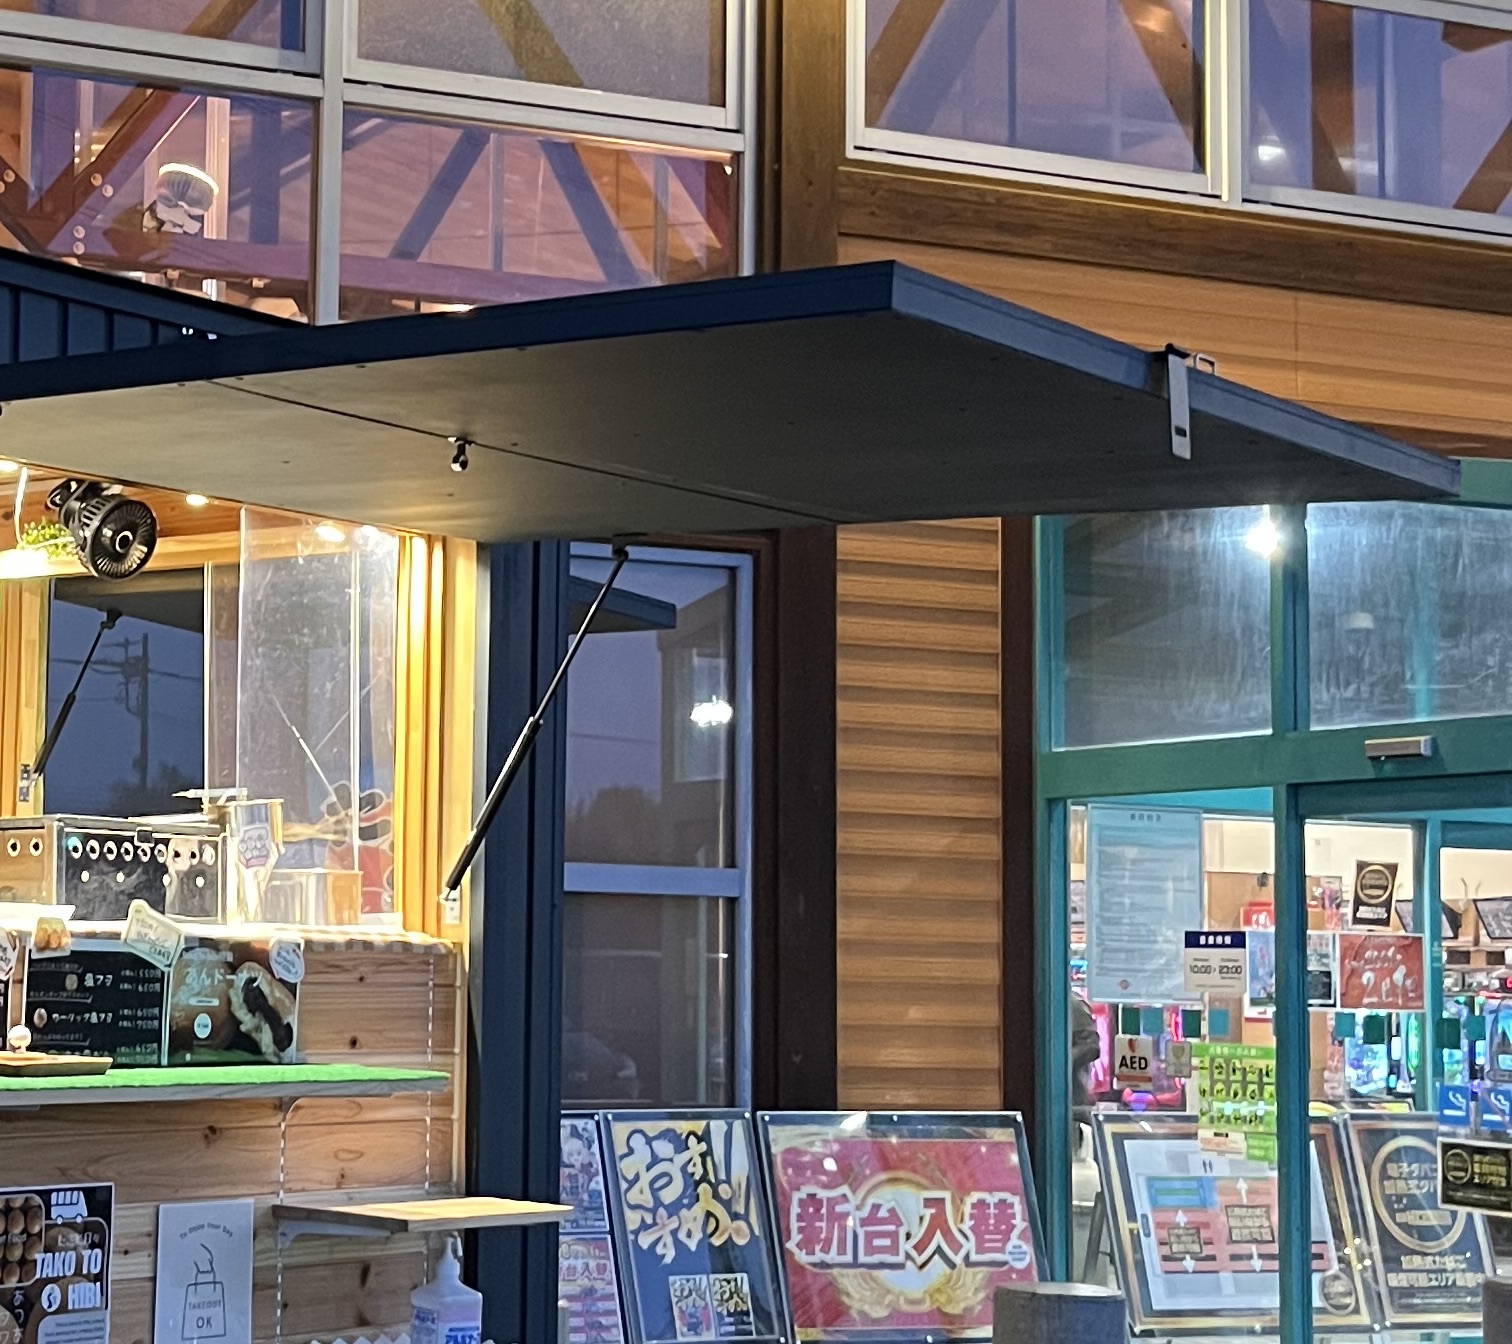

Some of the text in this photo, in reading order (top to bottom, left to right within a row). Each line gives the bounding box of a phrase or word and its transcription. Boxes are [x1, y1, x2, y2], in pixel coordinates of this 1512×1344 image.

[1190, 965, 1242, 975] 10:00 23:00
[1119, 1055, 1149, 1070] AED
[790, 1187, 1022, 1265] 新台入替
[35, 1248, 103, 1278] TAKO TO
[68, 1282, 101, 1310] HIBI
[188, 1299, 222, 1311] TAKEOUT
[195, 1316, 213, 1330] OK
